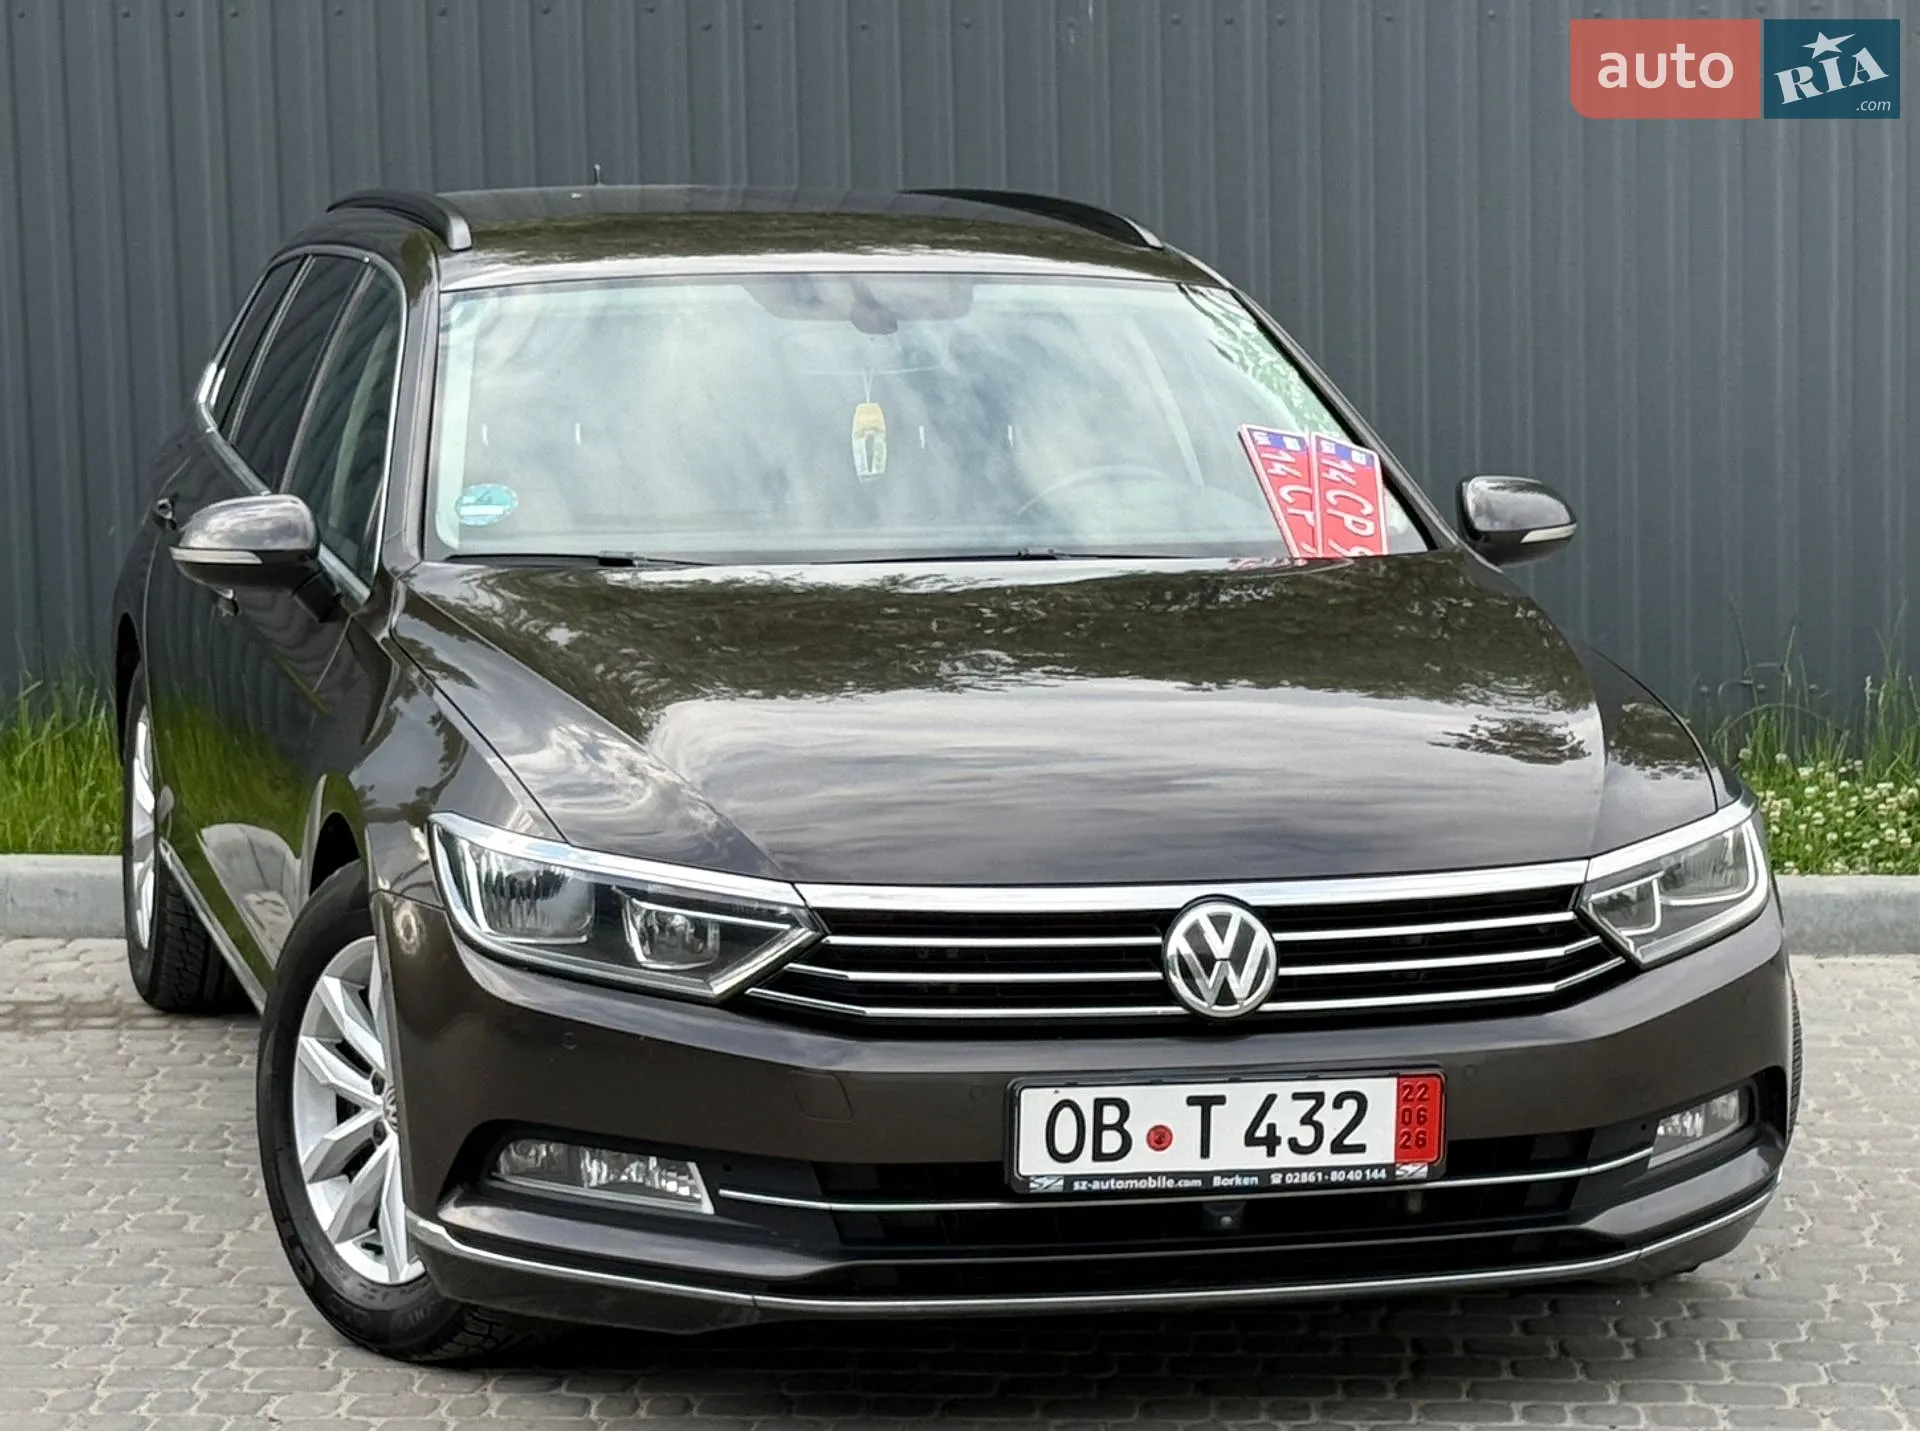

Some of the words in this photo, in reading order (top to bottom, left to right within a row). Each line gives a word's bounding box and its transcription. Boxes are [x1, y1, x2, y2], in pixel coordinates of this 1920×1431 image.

[1319, 457, 1357, 487] 14
[1325, 489, 1376, 537] CP
[1174, 907, 1270, 1012] VW
[1401, 1082, 1430, 1103] 22
[1044, 1097, 1133, 1164] OB
[1186, 1094, 1227, 1159] T
[1243, 1089, 1368, 1158] 432
[1400, 1105, 1429, 1126] 06
[1398, 1128, 1428, 1150] 26
[1072, 1175, 1203, 1191] sz-automobile.com
[1212, 1173, 1259, 1187] Borken
